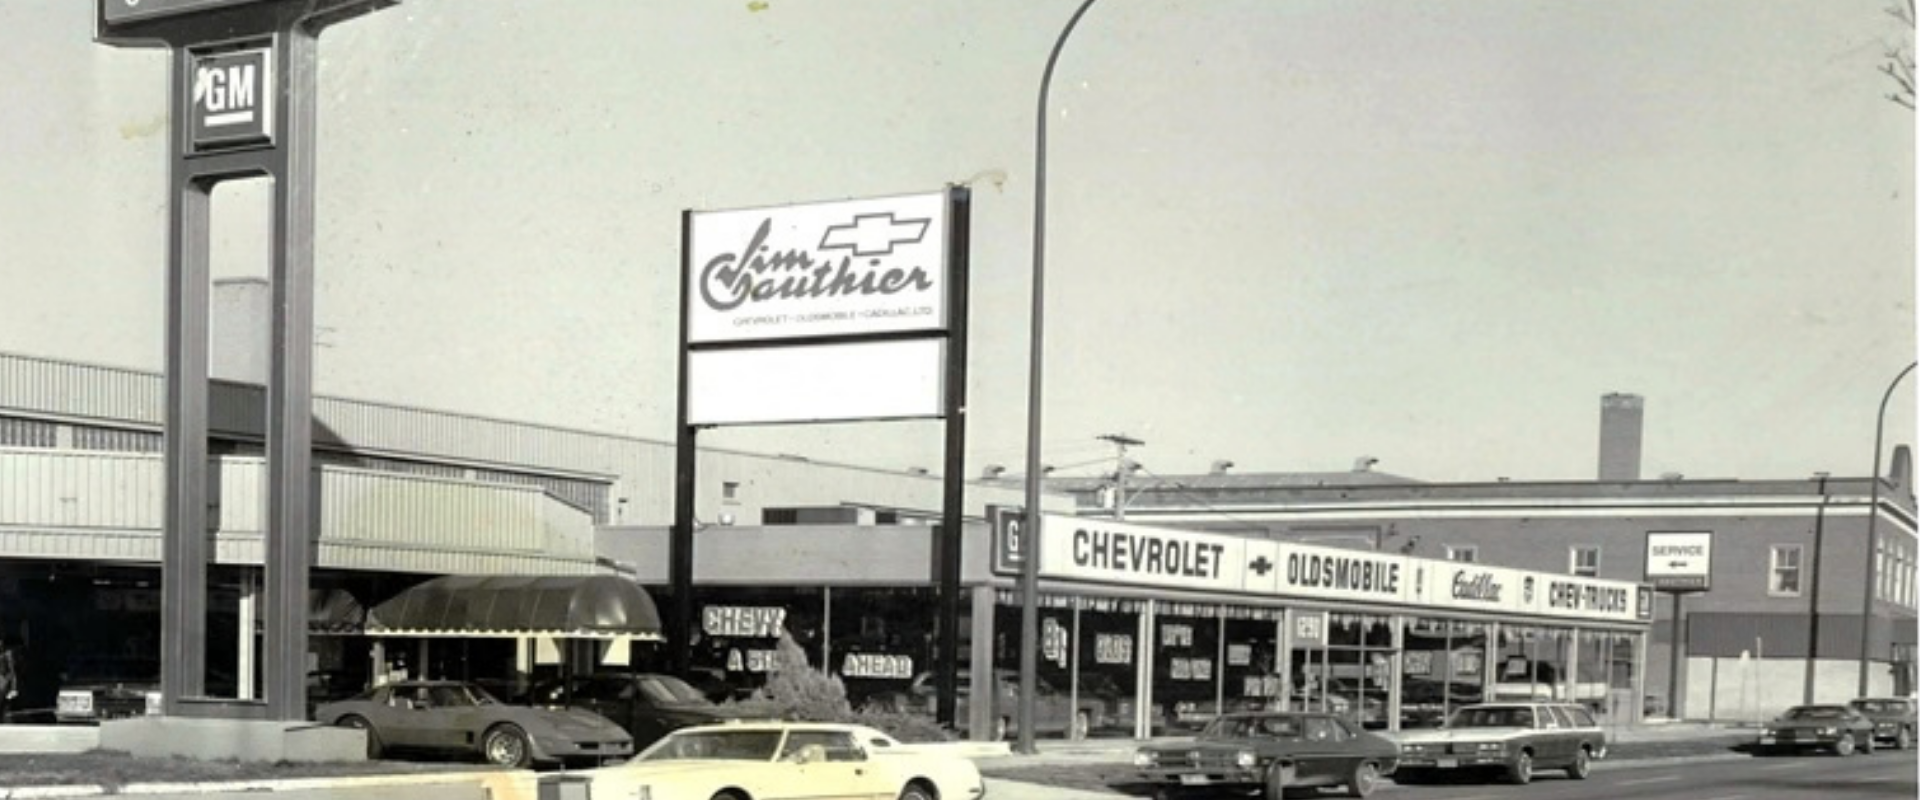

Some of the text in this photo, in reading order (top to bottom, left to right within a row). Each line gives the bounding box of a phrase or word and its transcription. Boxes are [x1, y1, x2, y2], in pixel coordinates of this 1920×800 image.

[205, 64, 255, 111] GM
[715, 217, 814, 288] Jim
[700, 253, 933, 311] Gauthier
[733, 313, 787, 326] CHEVROLET
[797, 310, 855, 322] OLDSMOBILE
[1007, 519, 1020, 553] G
[1652, 545, 1704, 557] SERVICE
[1073, 529, 1224, 580] CHEVROLET
[1287, 552, 1400, 595] OLDSMOBILE
[1451, 570, 1503, 603] Cadillac
[1549, 581, 1627, 613] CHEV-TRUCKS
[727, 648, 744, 671] A
[843, 653, 914, 678] AHEAD
